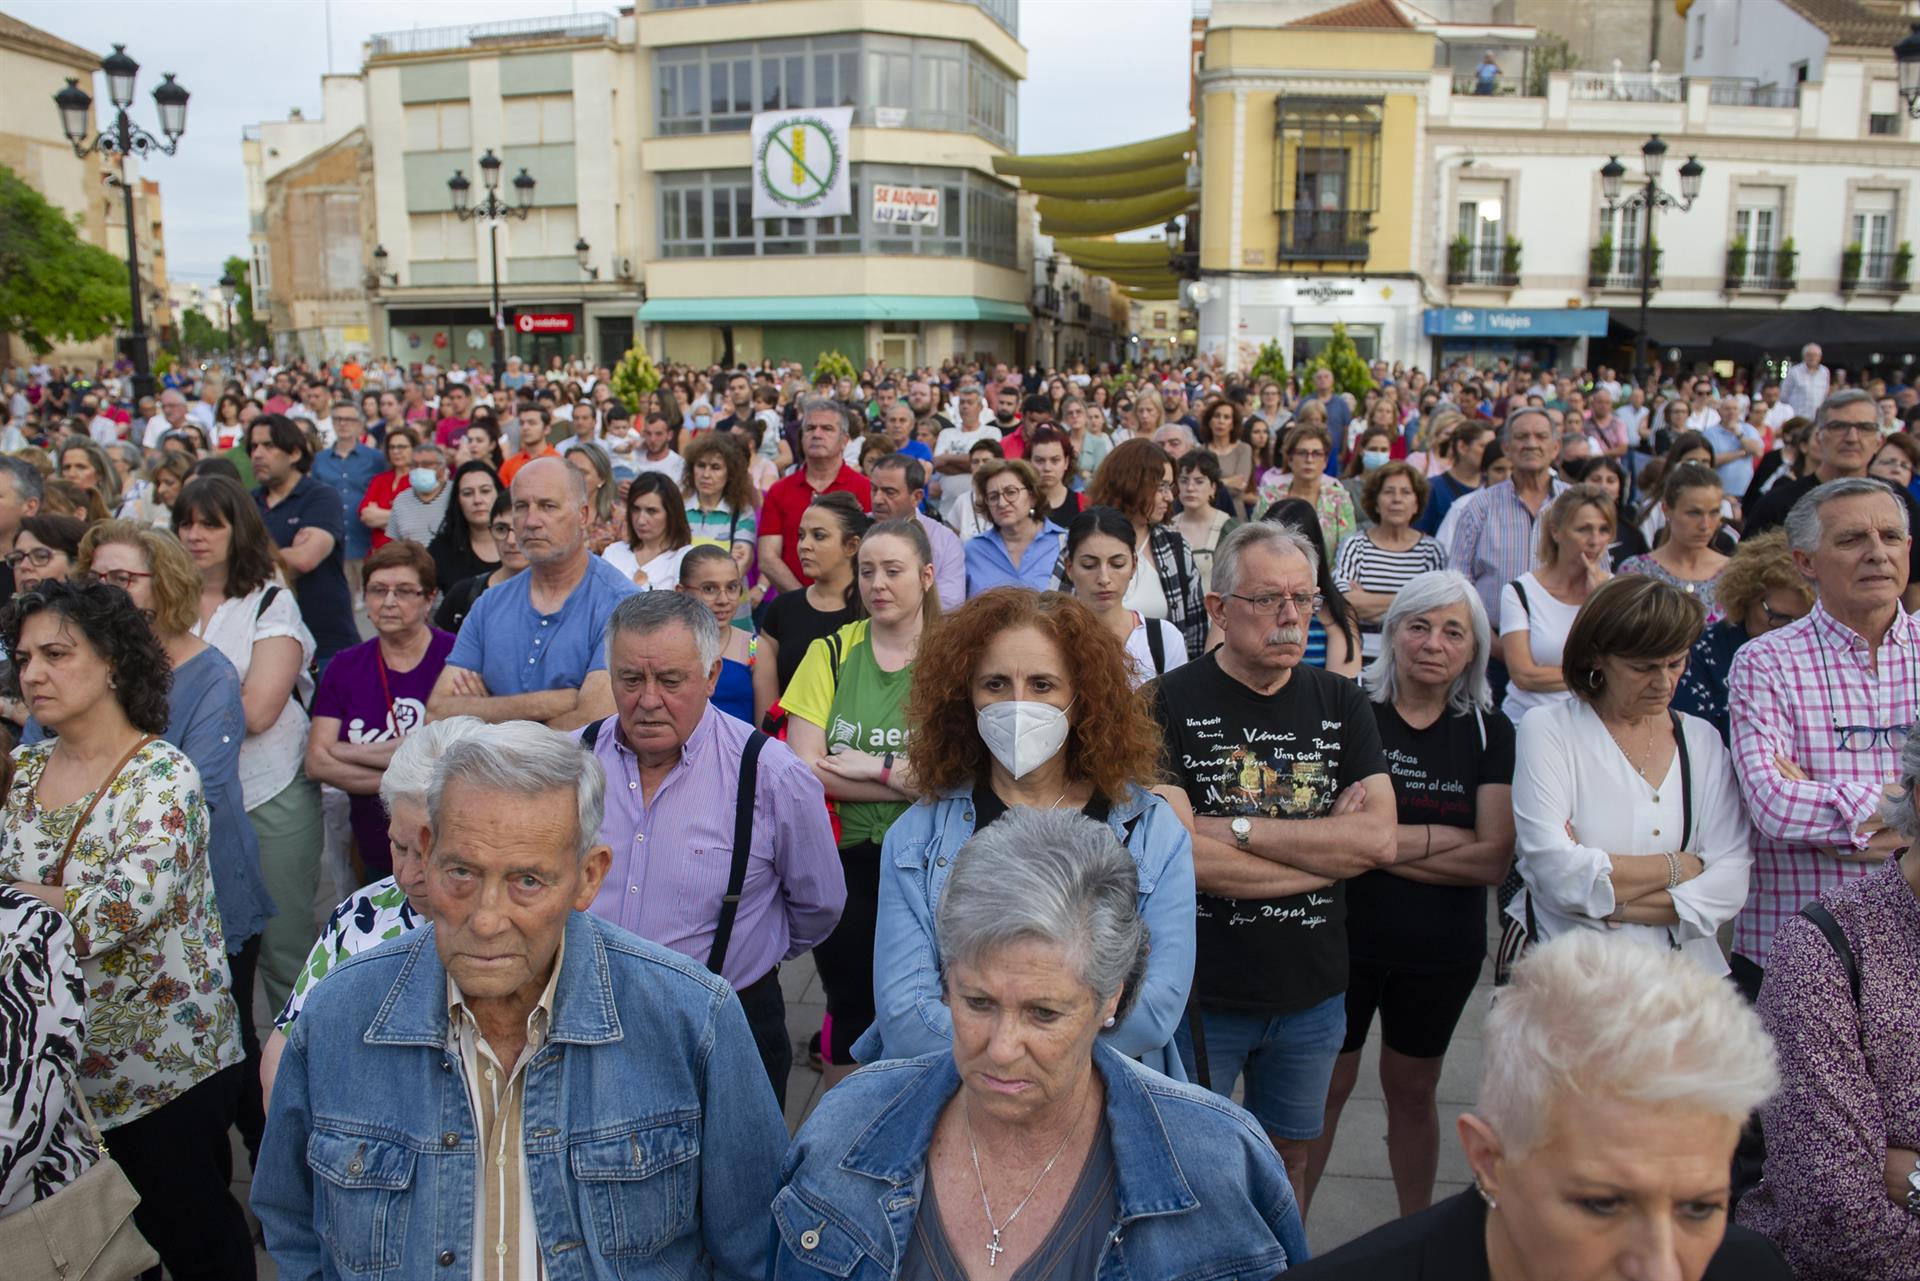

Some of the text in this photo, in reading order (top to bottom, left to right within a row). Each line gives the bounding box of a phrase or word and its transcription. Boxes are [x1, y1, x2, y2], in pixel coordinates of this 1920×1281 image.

[876, 188, 889, 203] SE
[1489, 314, 1532, 330] Viajes
[1388, 749, 1418, 765] chicas
[1391, 763, 1427, 778] buenas
[1405, 781, 1426, 790] van
[1428, 779, 1440, 790] al
